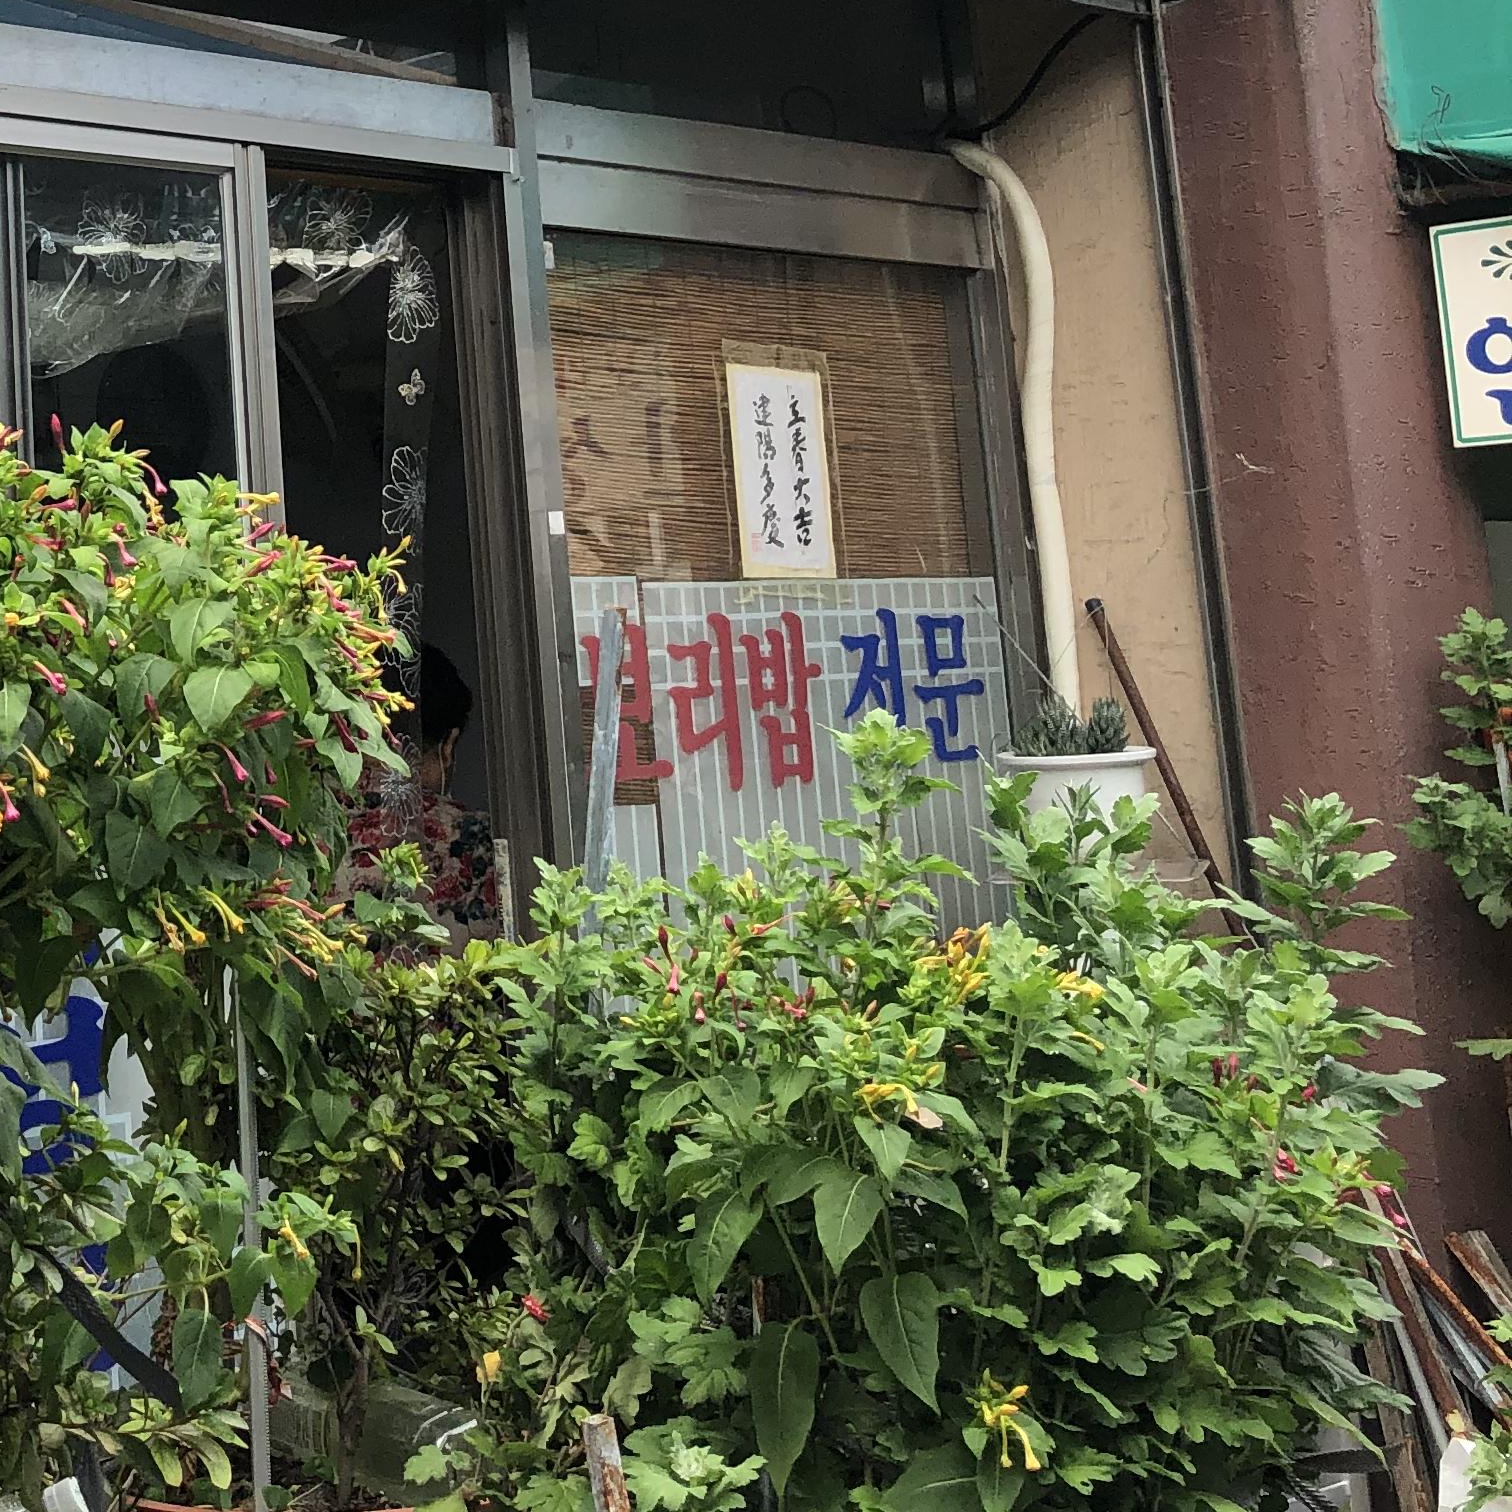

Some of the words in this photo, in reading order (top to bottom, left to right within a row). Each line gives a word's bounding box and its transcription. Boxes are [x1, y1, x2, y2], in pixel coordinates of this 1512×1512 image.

[752, 392, 785, 548] 建陽多慶
[787, 394, 814, 547] 立春大吉
